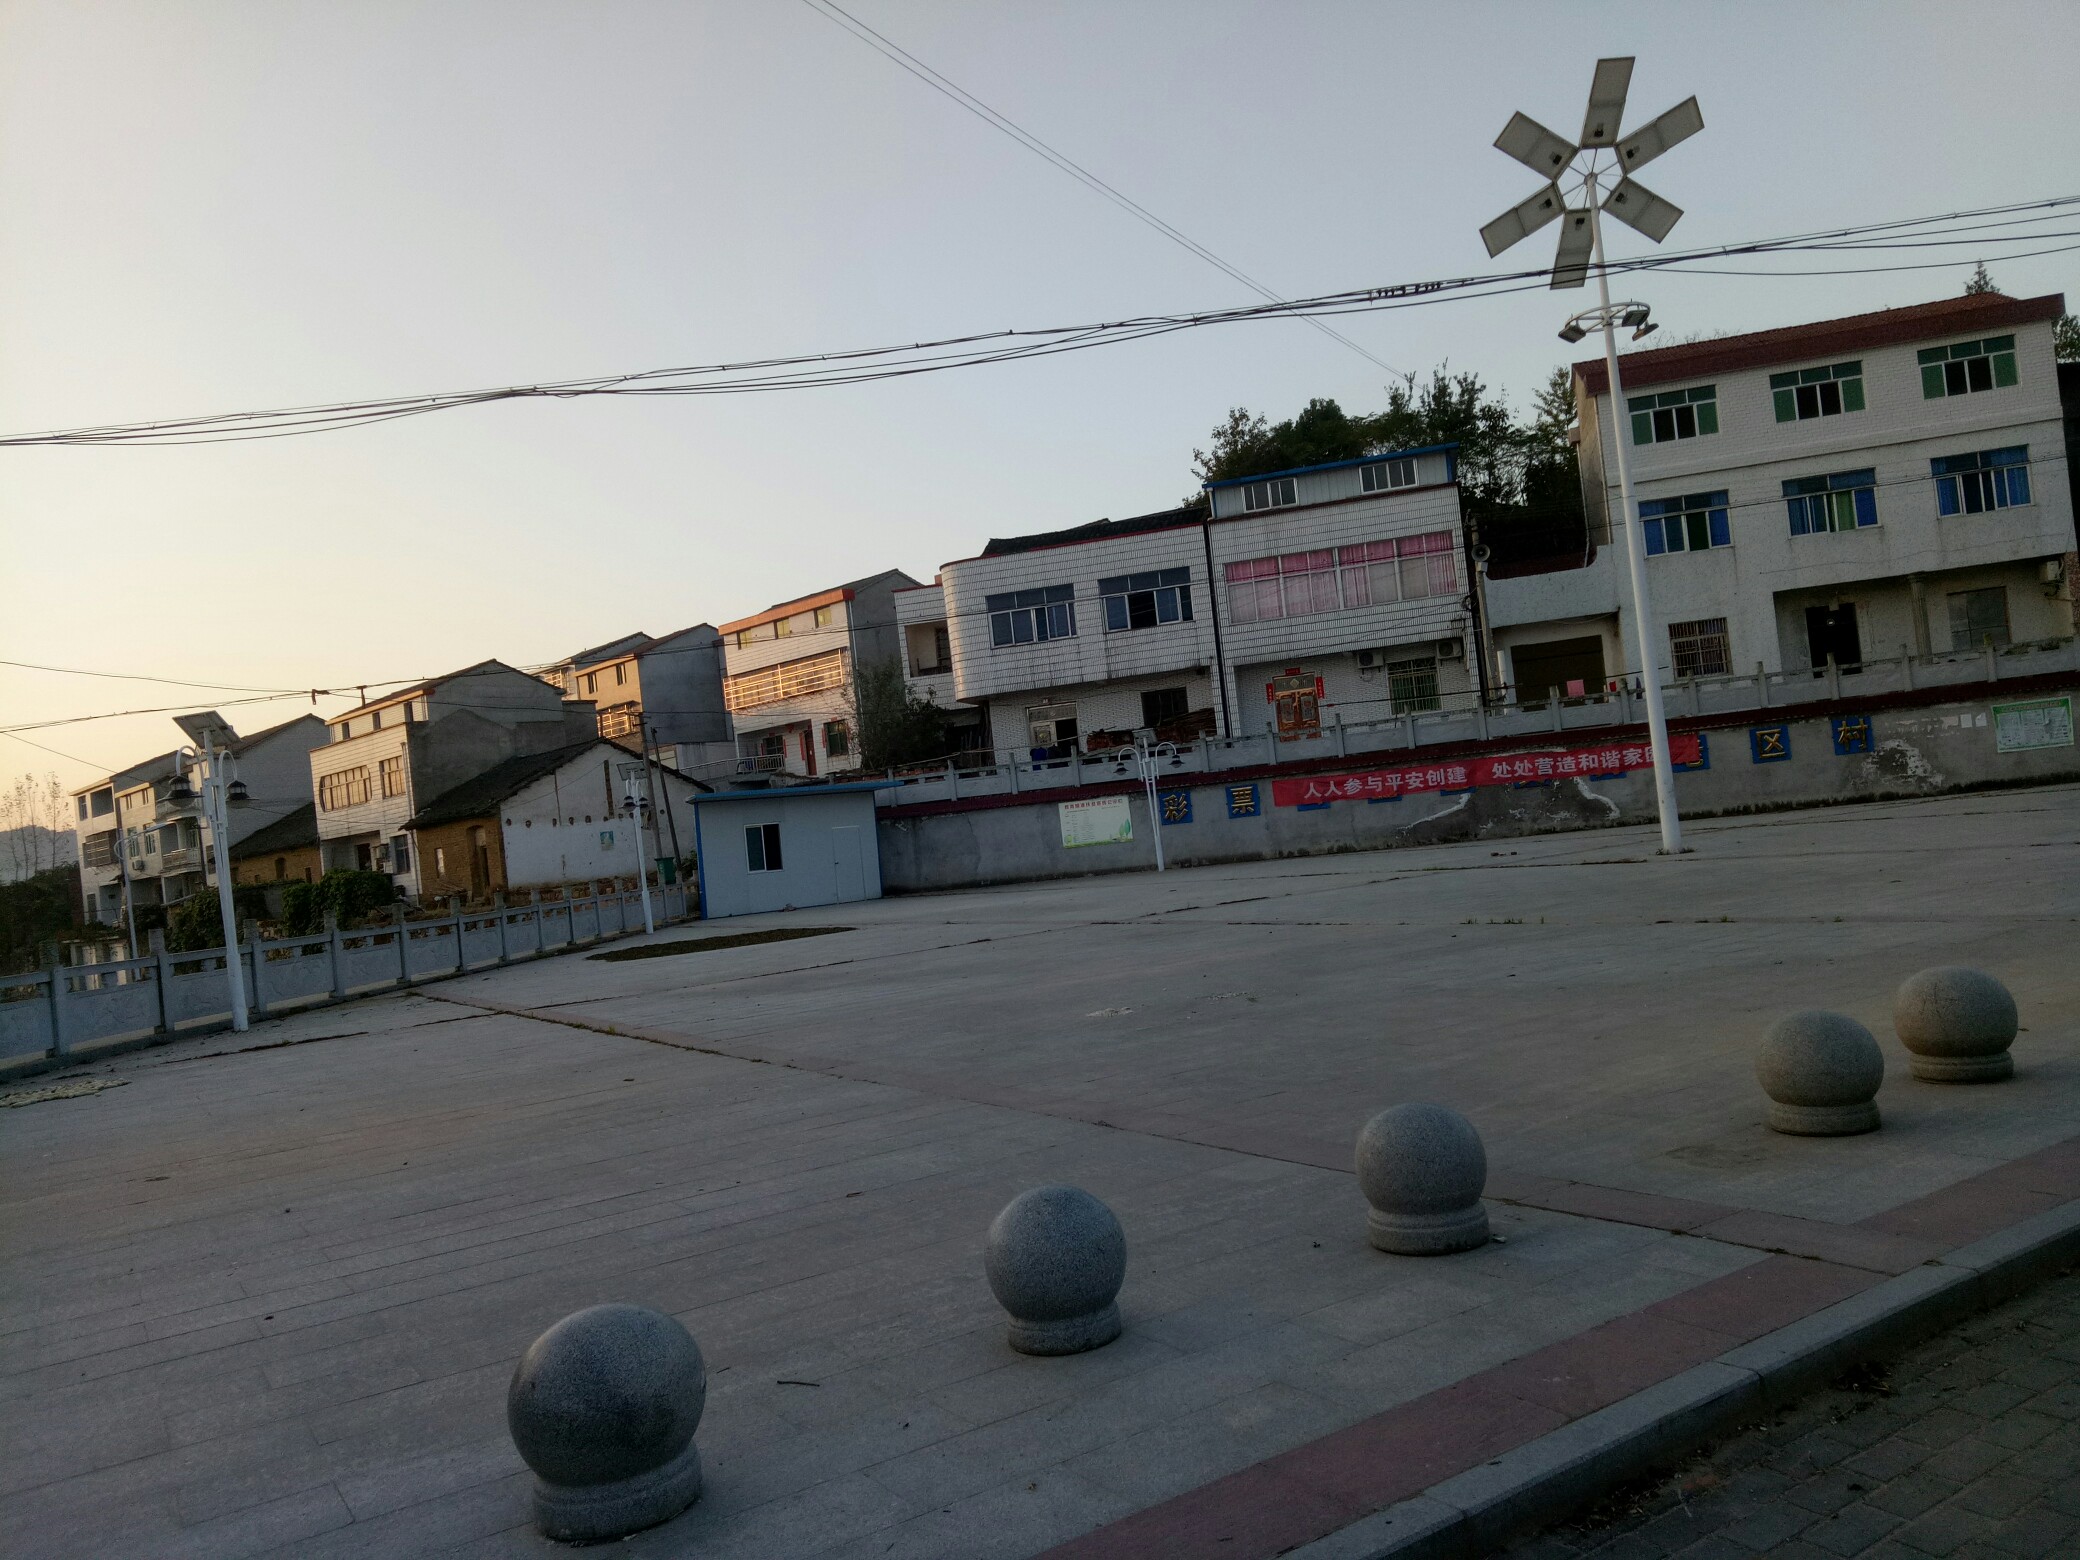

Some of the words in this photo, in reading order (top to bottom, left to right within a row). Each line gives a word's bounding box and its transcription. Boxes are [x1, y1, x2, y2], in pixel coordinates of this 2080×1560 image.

[1837, 719, 1868, 750] 村
[1304, 766, 1467, 798] 人人参与平安创建
[1162, 793, 1189, 822] 彩
[1229, 786, 1256, 815] 票
